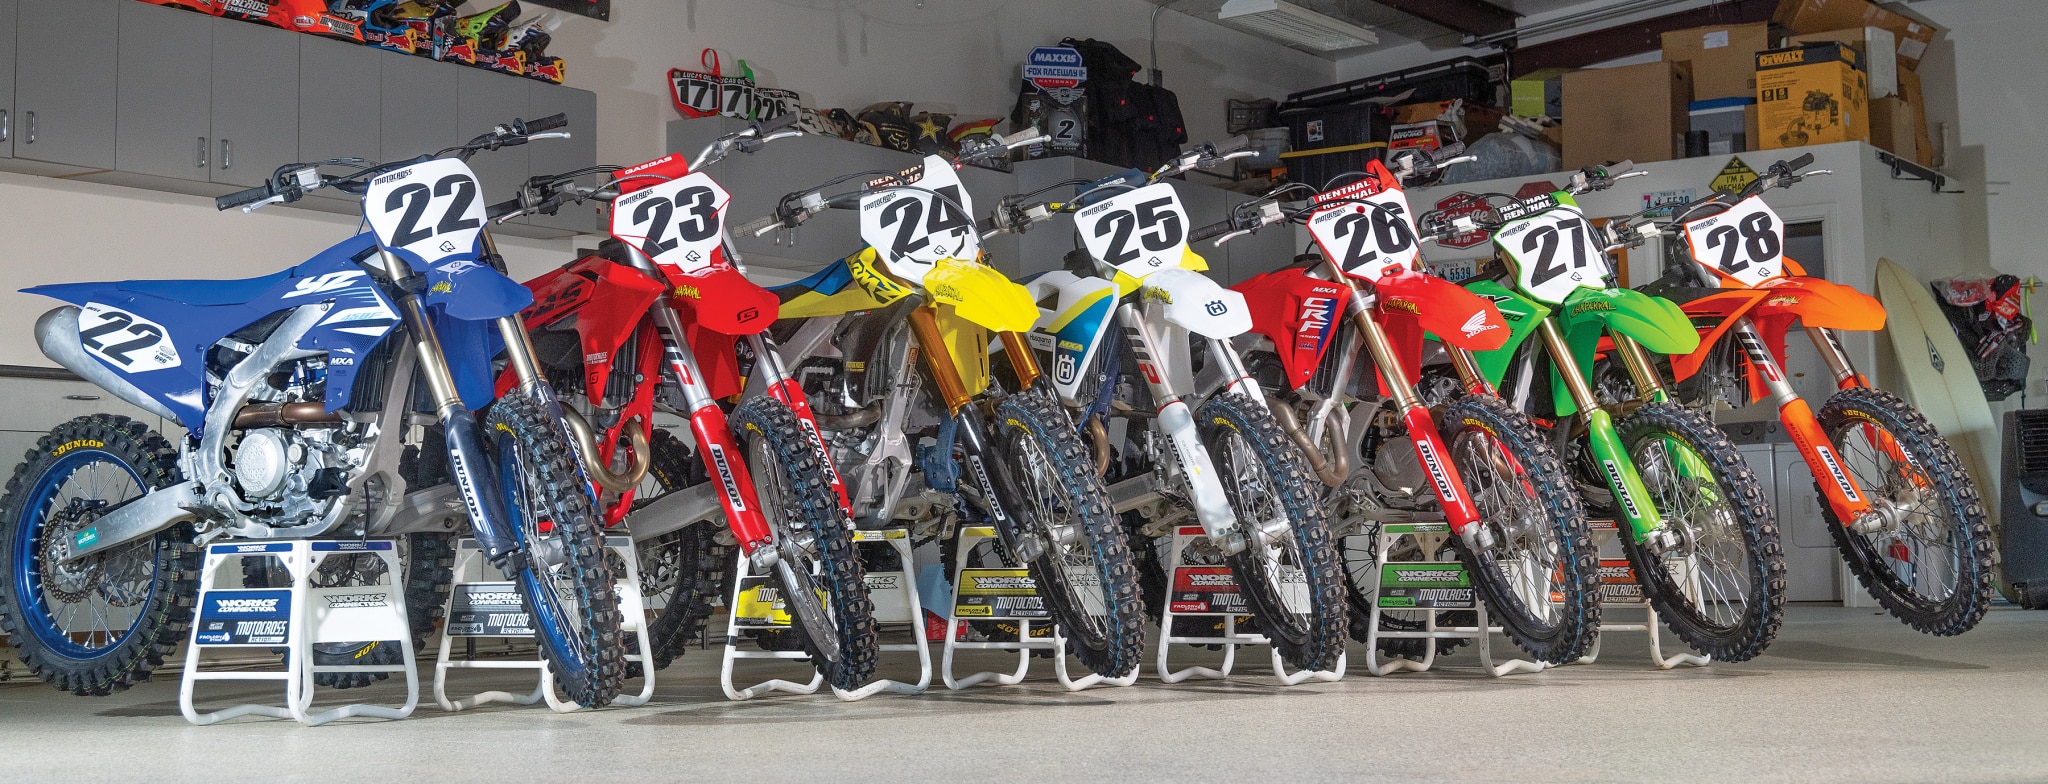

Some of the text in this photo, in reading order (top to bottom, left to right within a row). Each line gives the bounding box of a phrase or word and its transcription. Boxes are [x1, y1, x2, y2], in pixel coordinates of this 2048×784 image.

[1034, 53, 1077, 63] MAXXIS
[1027, 67, 1042, 76] FOX
[1043, 68, 1078, 77] RACEWAY
[677, 78, 718, 109] 171
[1056, 118, 1076, 139] 2
[624, 155, 673, 175] GASGAS
[374, 168, 413, 186] MOTOCROSS
[1726, 175, 1738, 184] I'M
[618, 187, 654, 207] MOTOCROSS
[1317, 180, 1372, 202] RENTHAL
[1717, 181, 1750, 194] MECHAN
[384, 173, 481, 247] 22
[863, 191, 897, 212] MOTOCROSS
[1081, 200, 1114, 218] MOTOCROSS
[632, 185, 720, 258] 23
[879, 184, 970, 264] 24
[1314, 207, 1347, 225] MOTOCROSS
[1689, 216, 1718, 232] MOTOCROSS
[1094, 195, 1183, 267] 25
[1333, 201, 1412, 273] 26
[1500, 220, 1531, 239] MOTOCROSS
[1522, 217, 1587, 289] 27
[1706, 211, 1781, 276] 28
[1449, 266, 1471, 281] 5539
[281, 270, 366, 299] YZ
[1311, 286, 1337, 294] MXA
[1299, 297, 1333, 333] CRF
[1384, 297, 1422, 316] CHAPARRAL
[1570, 299, 1617, 318] CHAPARRAL
[79, 311, 163, 367] 22
[1465, 324, 1501, 339] HONDA
[1058, 339, 1084, 353] MXA
[330, 357, 354, 366] MXA
[57, 439, 105, 456] DUNLOP
[1165, 434, 1194, 490] DUNLOP
[1420, 444, 1452, 499] DUNLOP
[712, 448, 743, 508] DUNLOP
[1821, 449, 1856, 499] DUNLOP
[453, 454, 480, 518] DUNLOP
[973, 458, 1004, 517] DUNLOP
[1606, 463, 1638, 516] DUNLOP
[973, 576, 1036, 584] WORKS
[215, 598, 280, 607] WORKS
[323, 592, 387, 602] WORKS
[329, 601, 389, 609] CONNECTION
[1418, 588, 1473, 606] MOTOCROSS
[235, 620, 288, 640] MOTOCROSS
[487, 613, 530, 632] MOTOCRO
